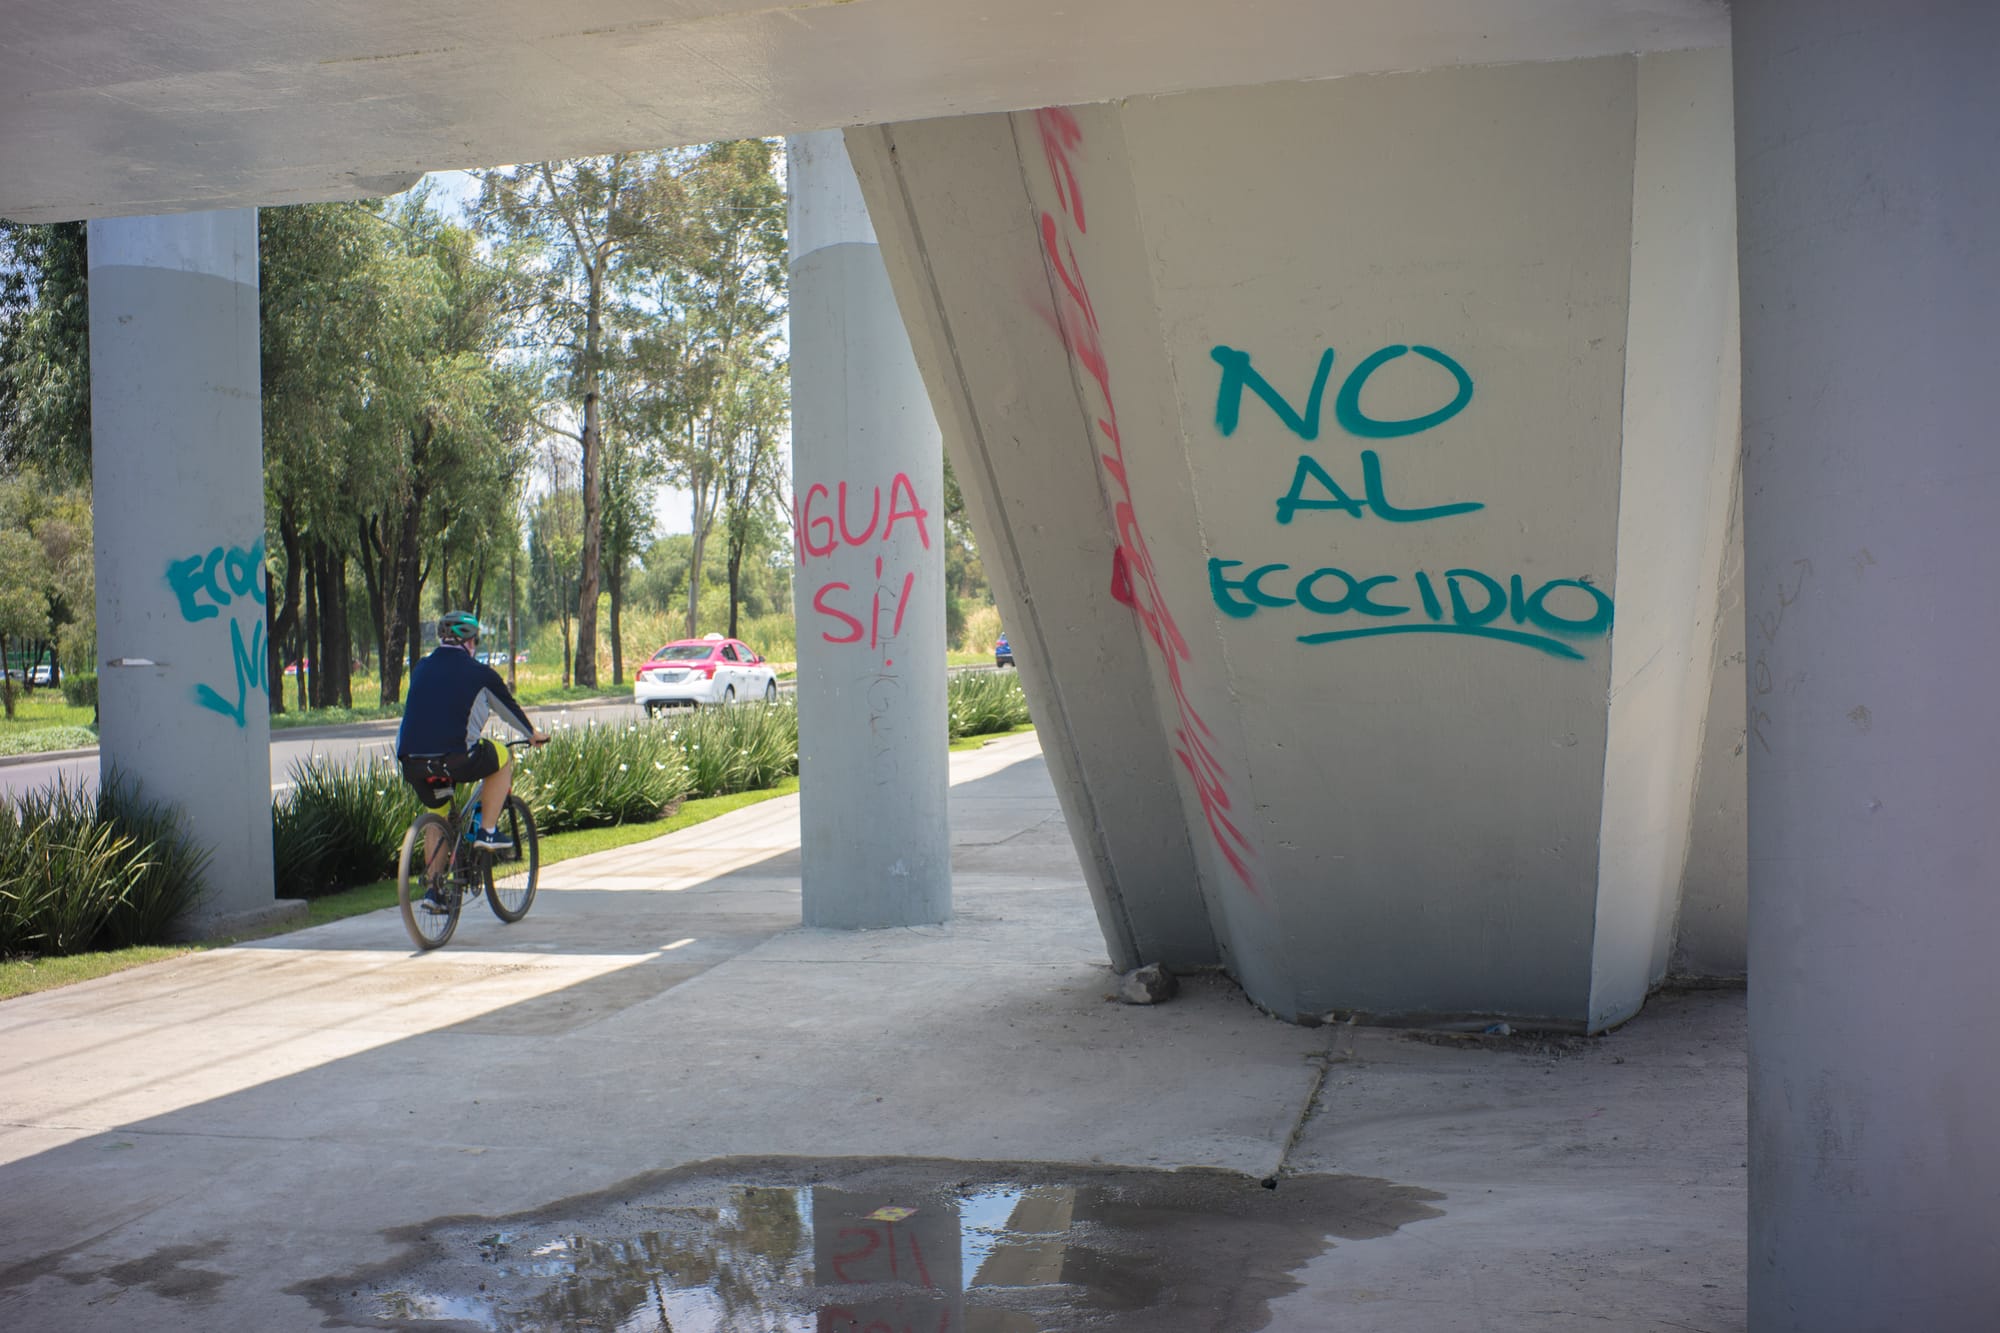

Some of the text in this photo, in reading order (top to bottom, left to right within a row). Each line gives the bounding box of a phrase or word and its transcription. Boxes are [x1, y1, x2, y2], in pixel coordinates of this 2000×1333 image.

[1210, 344, 1474, 442] NO
[1275, 449, 1486, 525] AL
[1207, 556, 1615, 639] ECOCIDIO
